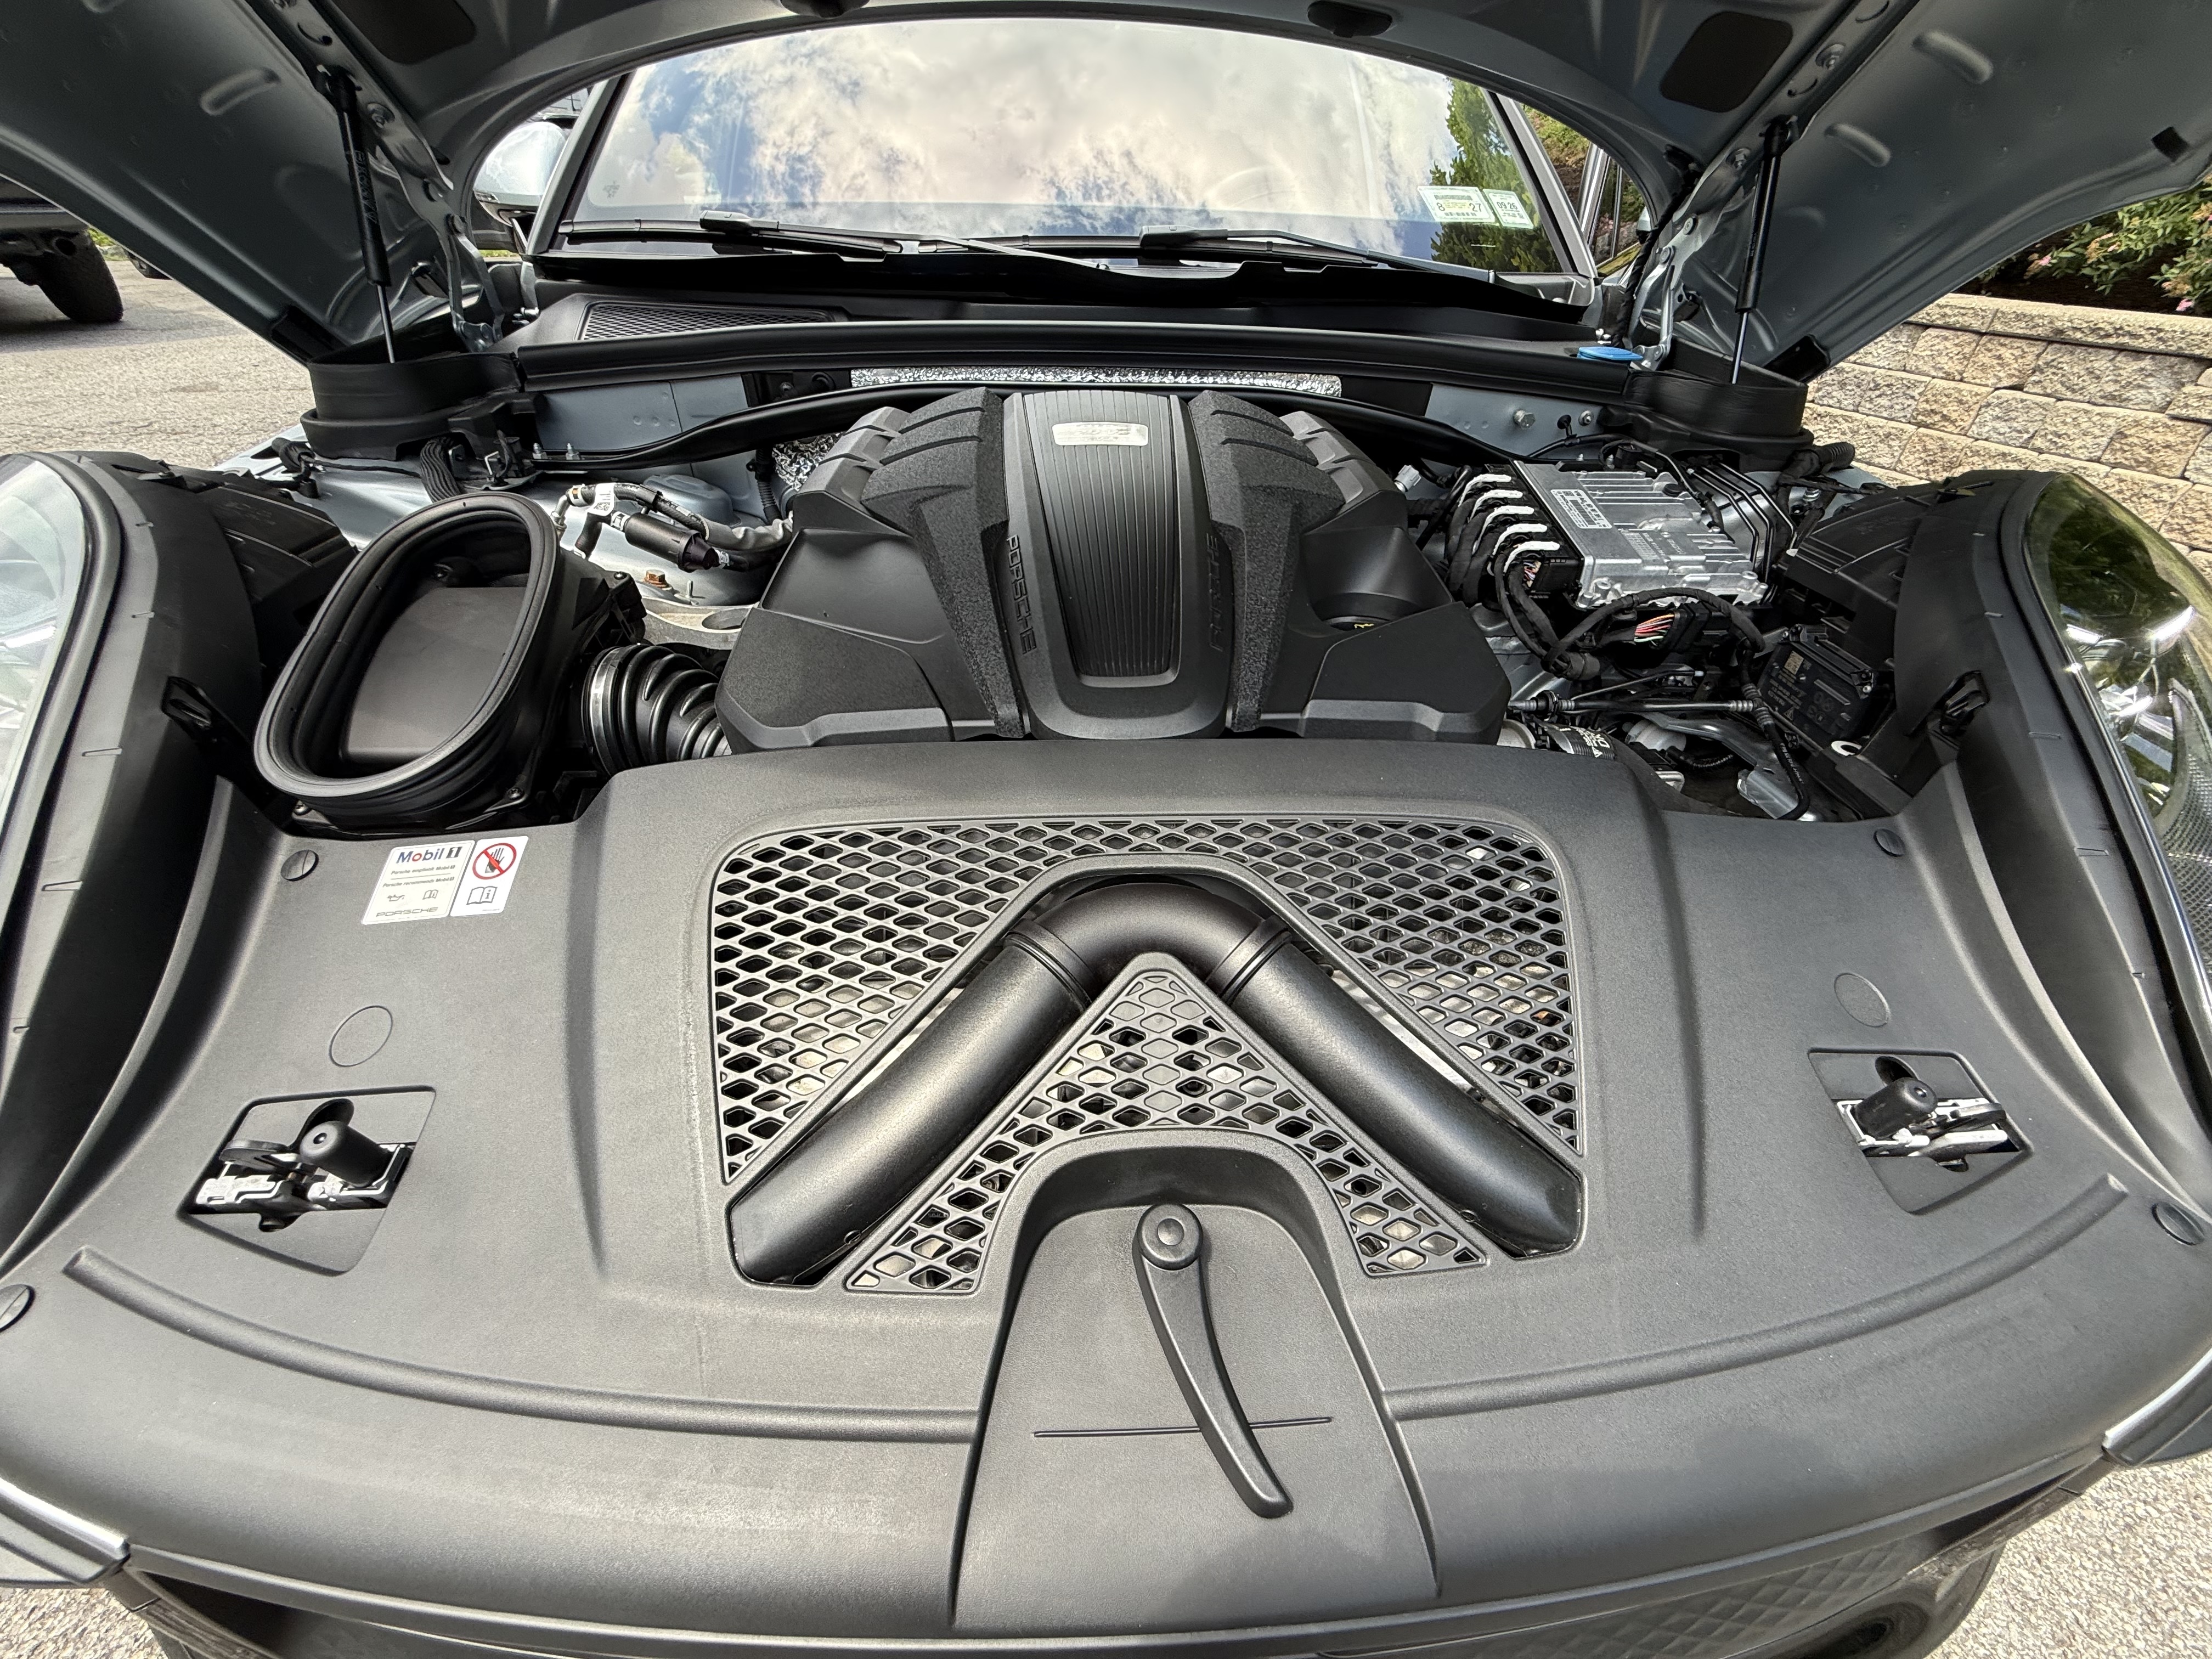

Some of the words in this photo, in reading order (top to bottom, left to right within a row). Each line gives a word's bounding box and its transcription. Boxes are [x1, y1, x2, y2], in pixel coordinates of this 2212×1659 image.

[1436, 202, 1446, 212] 8
[1469, 203, 1482, 212] 27
[1508, 202, 1518, 210] 26
[1006, 533, 1037, 655] PORSCHE
[396, 848, 445, 864] Mobil
[446, 847, 462, 859] 1
[376, 907, 438, 917] PORSCHE
